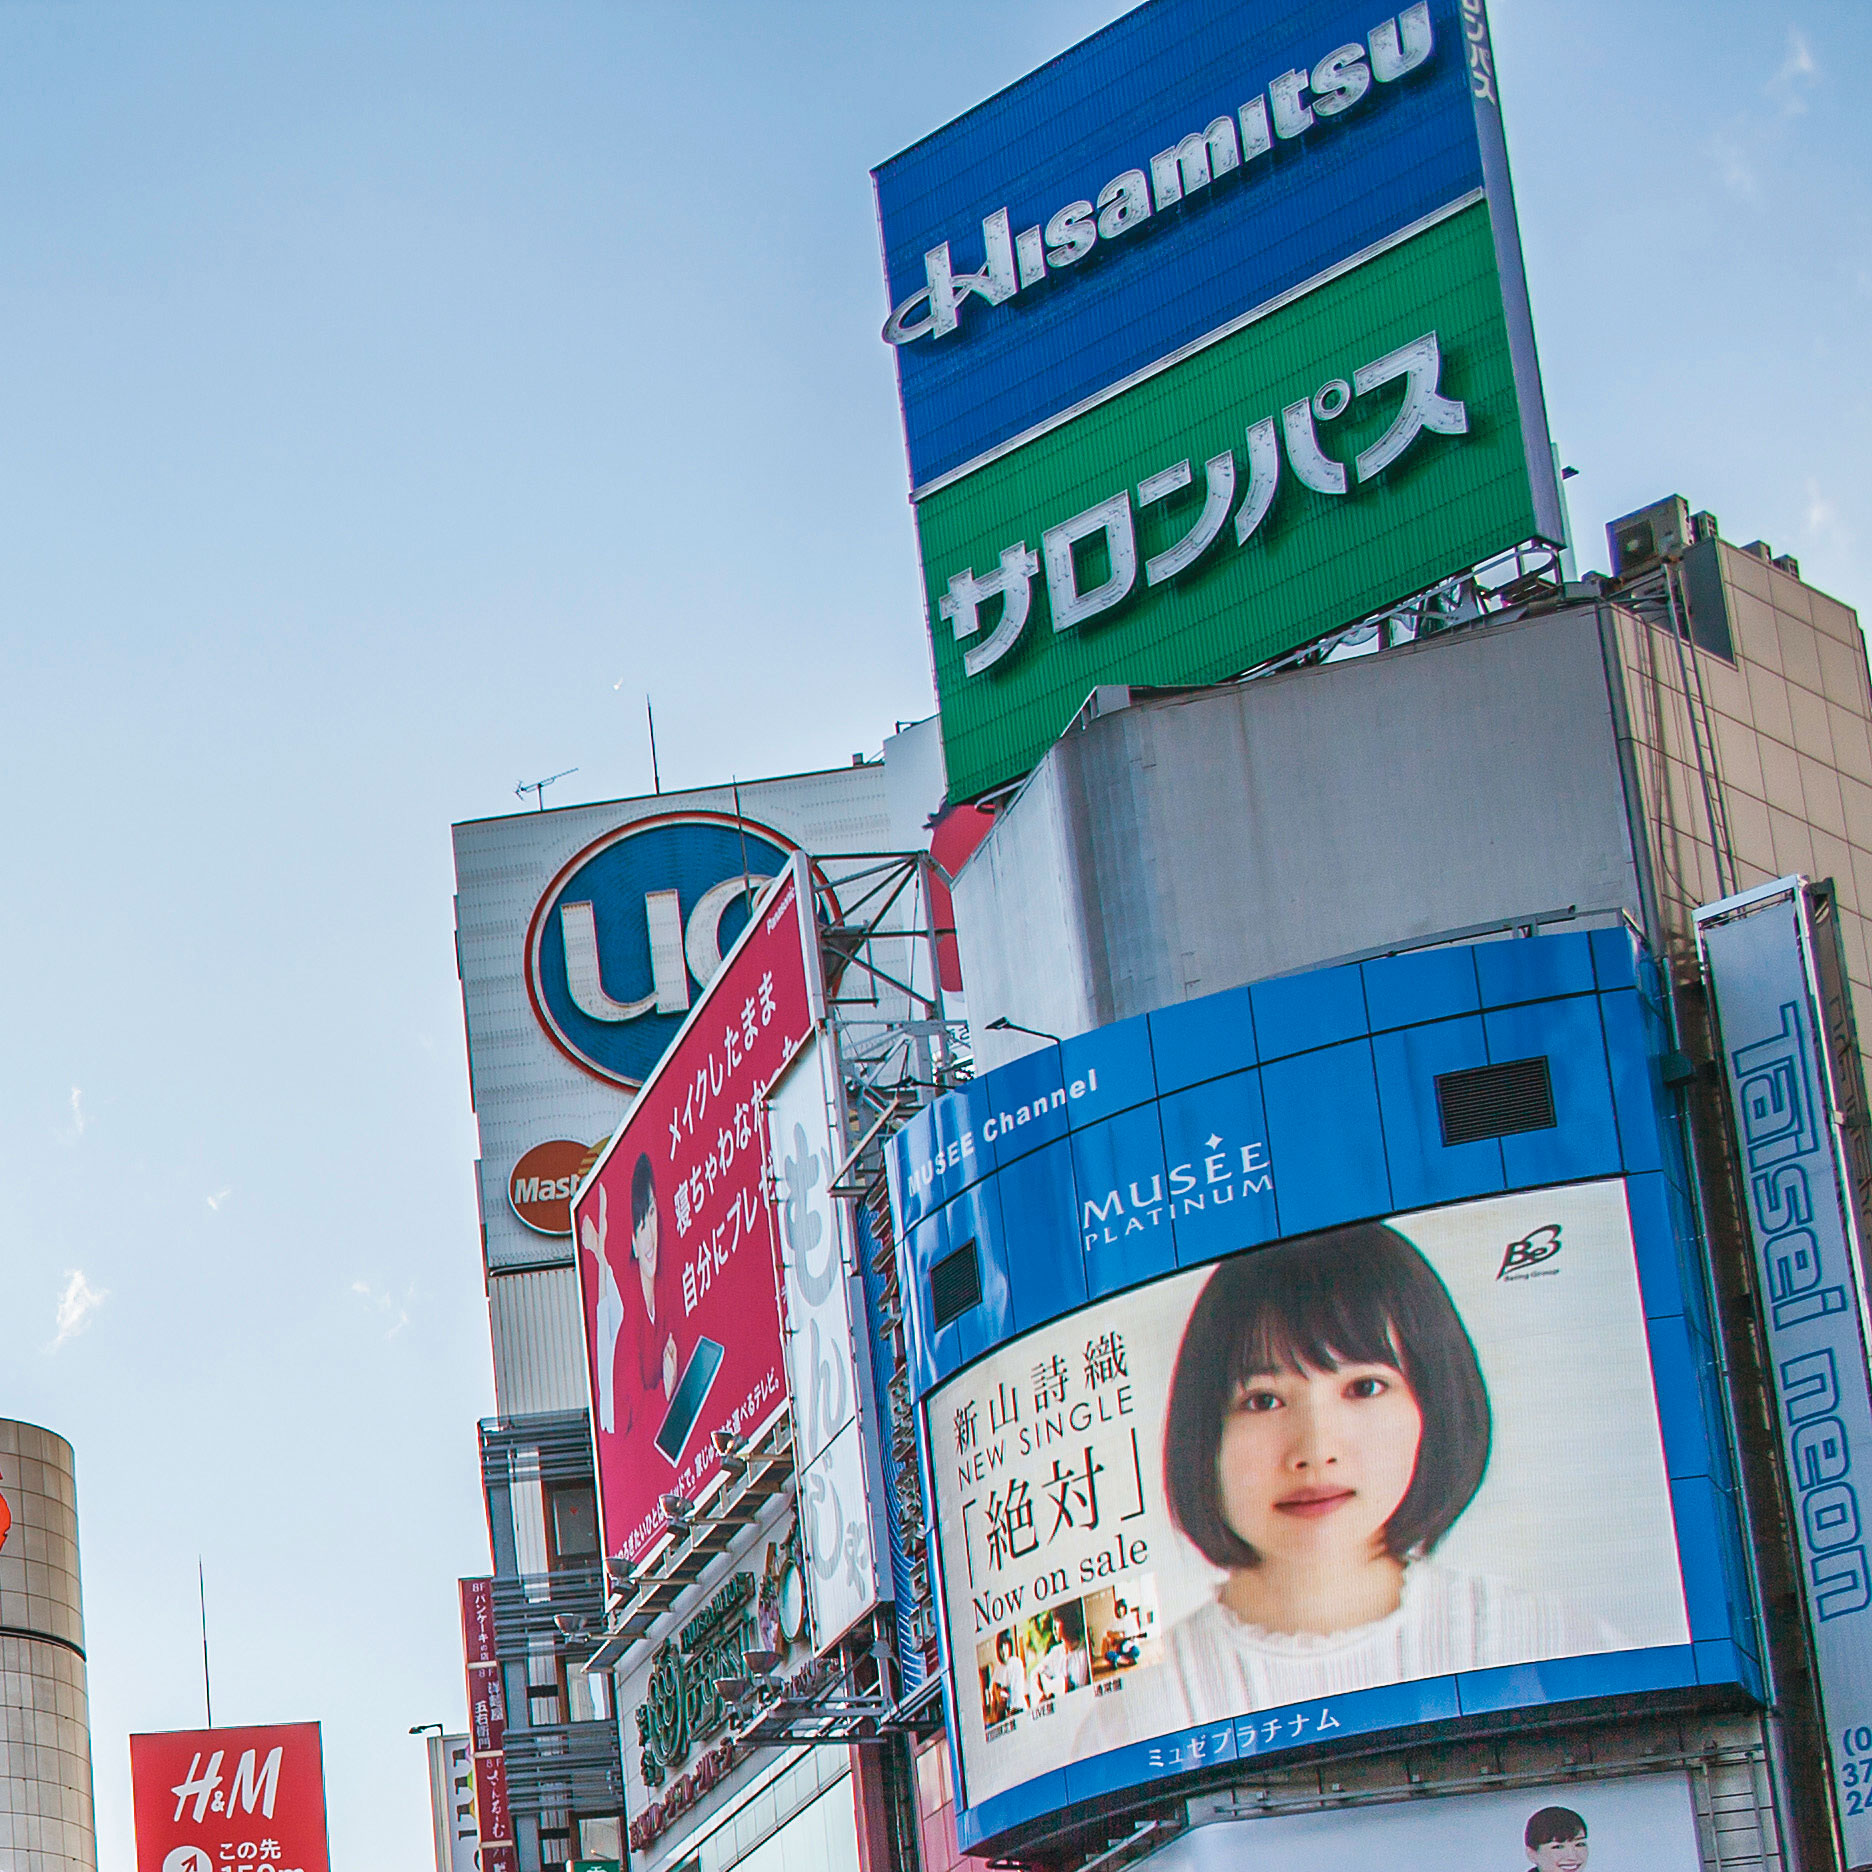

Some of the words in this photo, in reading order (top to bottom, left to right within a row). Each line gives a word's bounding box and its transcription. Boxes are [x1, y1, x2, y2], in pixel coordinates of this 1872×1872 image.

[881, 1, 1435, 346] Hisamitsu
[938, 330, 1470, 678] サロンパス
[668, 969, 777, 1162] メイクしたまま
[907, 1133, 976, 1195] MUSEE
[982, 1069, 1099, 1145] Channel
[1730, 1003, 1847, 1332] Taisei
[1083, 1173, 1275, 1252] PLATINUM
[952, 1332, 1131, 1455] 新山詩織
[957, 1443, 1008, 1490] NEW
[1018, 1385, 1135, 1461] SINGLE
[961, 1427, 1149, 1590] 「絶対」
[1777, 1348, 1872, 1622] neon
[972, 1587, 1026, 1634] Now
[1032, 1570, 1073, 1605] on
[1077, 1537, 1151, 1585] sale
[172, 1746, 284, 1825] H&M
[1147, 1708, 1342, 1768] ミュゼプラチナム
[219, 1840, 283, 1863] この先
